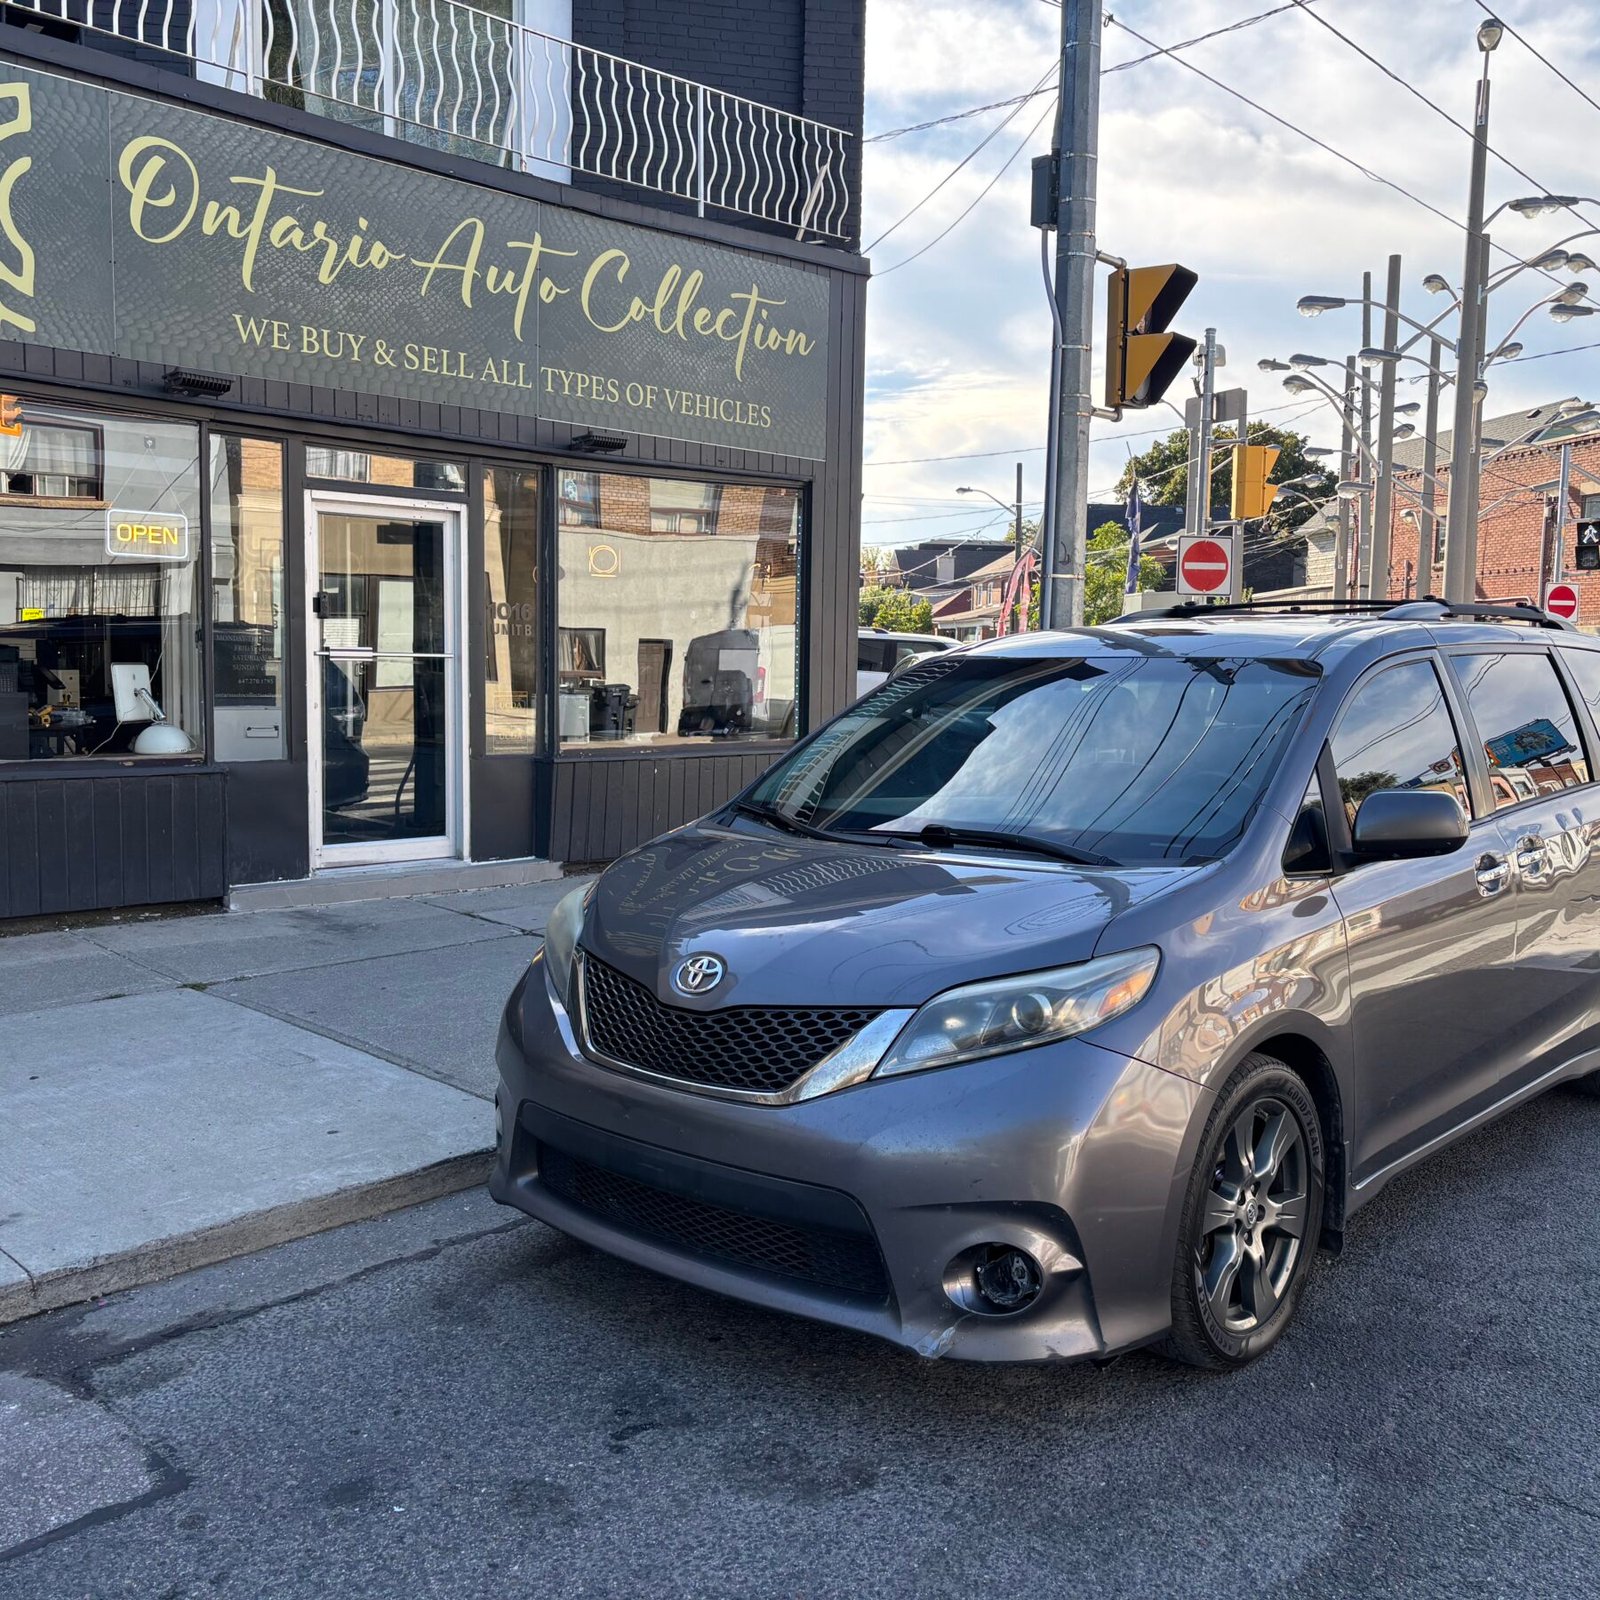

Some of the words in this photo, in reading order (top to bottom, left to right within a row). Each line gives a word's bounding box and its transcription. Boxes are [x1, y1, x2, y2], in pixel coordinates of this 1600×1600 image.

[118, 135, 406, 294] Ontario
[410, 217, 579, 342] Auto
[581, 248, 816, 382] Collection
[232, 313, 292, 351] WE
[300, 324, 367, 363] BUY
[373, 338, 398, 368] &
[404, 343, 475, 380] SELL
[482, 356, 533, 389] ALL
[540, 366, 620, 403] TYPES
[625, 382, 659, 410] OF
[663, 388, 773, 428] VEHICLES
[116, 523, 178, 545] OPEN
[487, 602, 533, 621] 1016
[491, 623, 523, 636] UNIT
[524, 624, 532, 636] B
